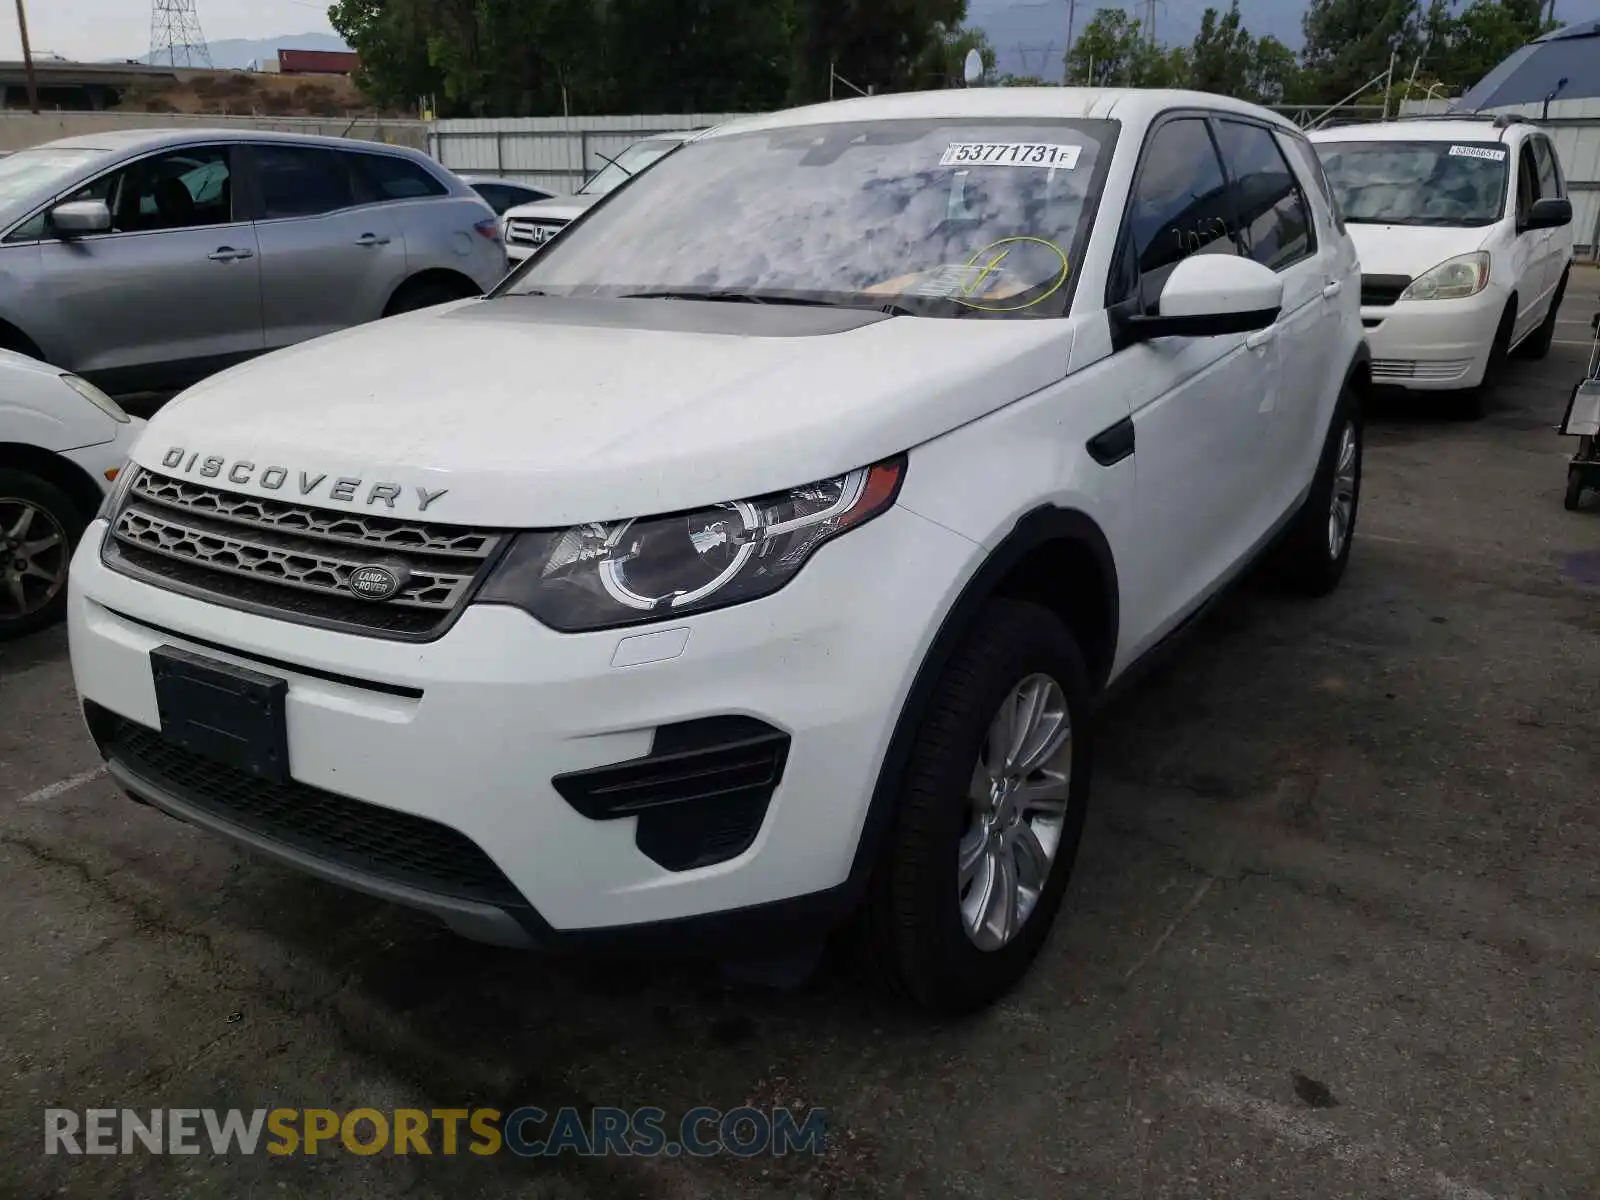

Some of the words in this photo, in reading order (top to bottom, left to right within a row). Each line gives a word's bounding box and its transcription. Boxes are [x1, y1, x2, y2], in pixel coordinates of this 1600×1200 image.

[162, 446, 448, 512] DISCOVERY
[359, 571, 381, 582] LAND
[359, 581, 387, 593] ROVER
